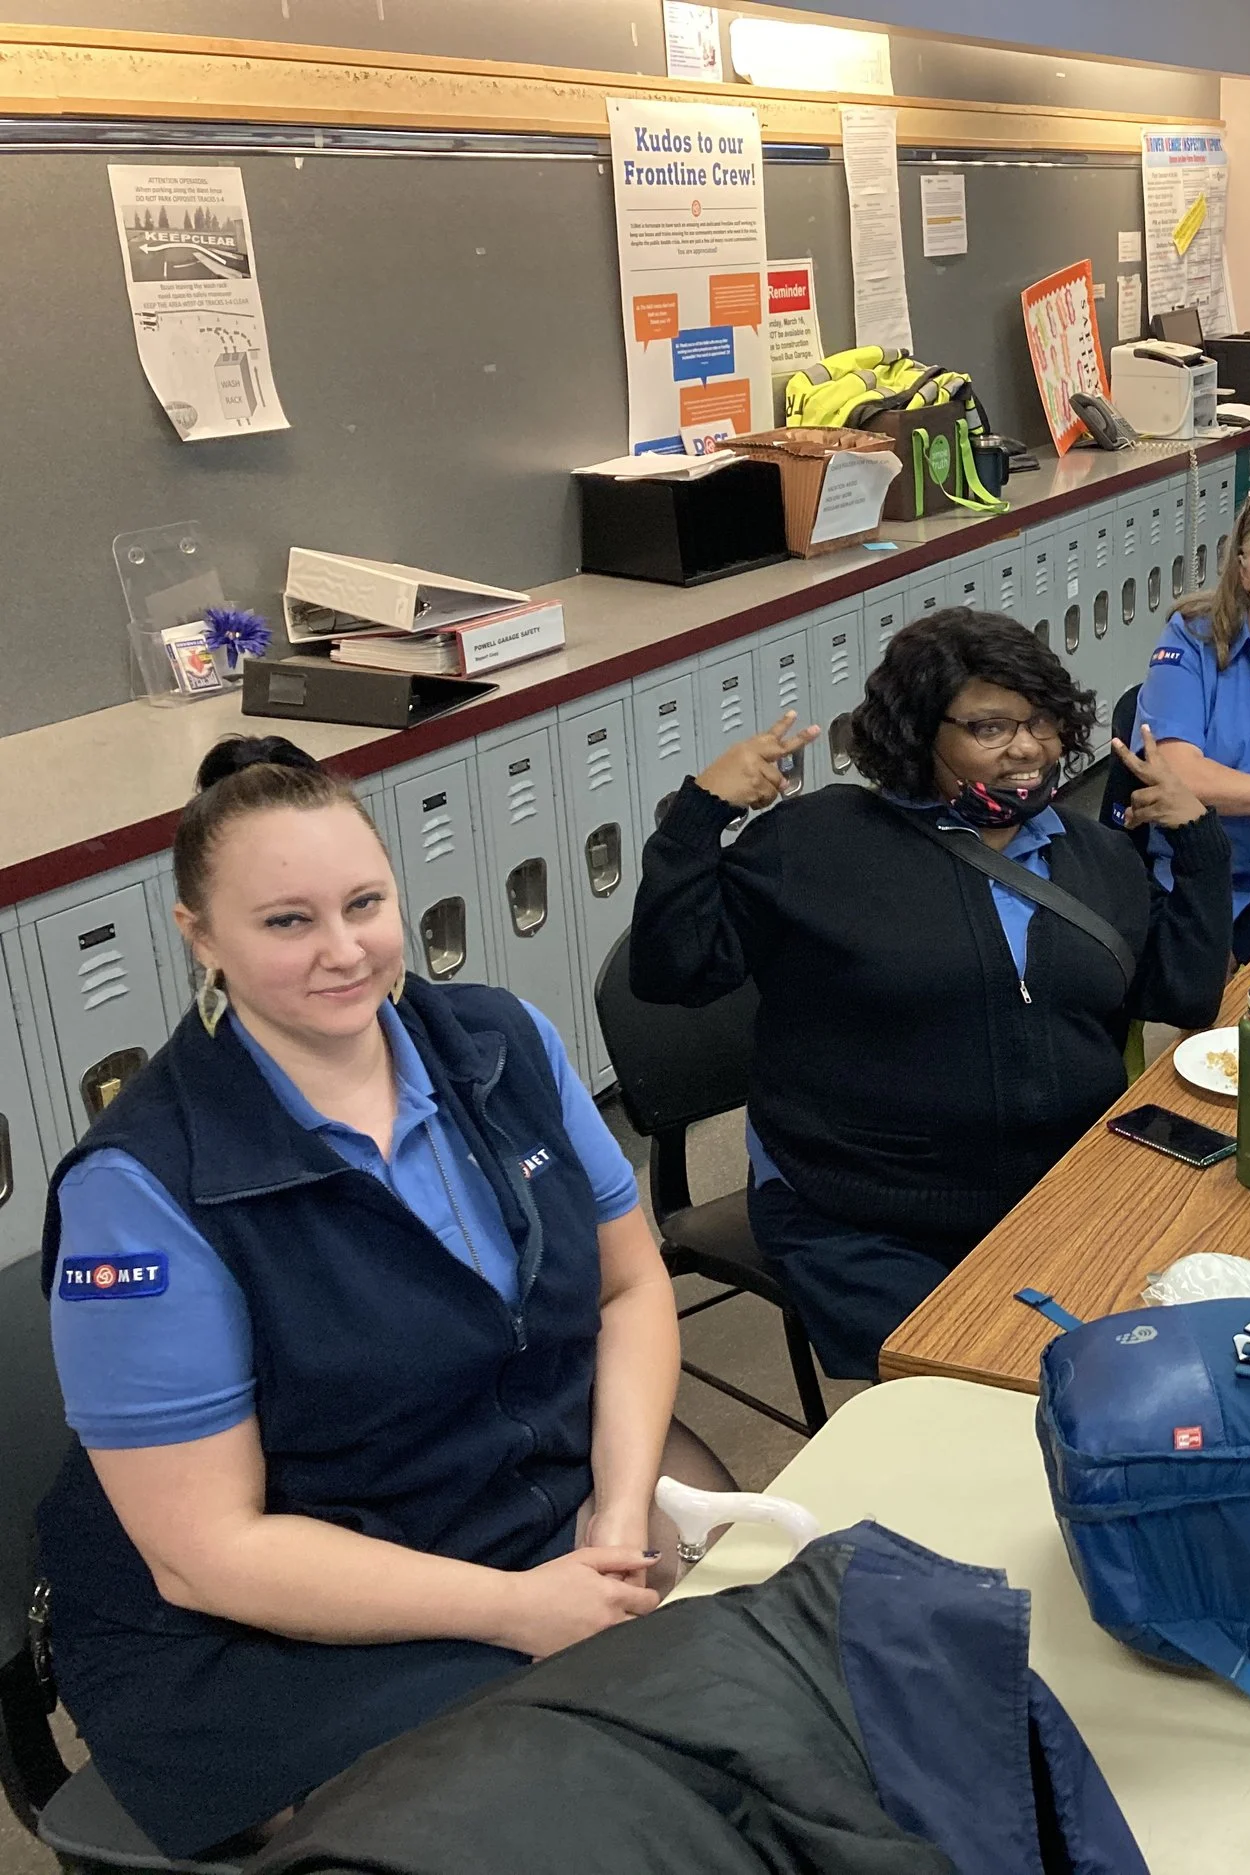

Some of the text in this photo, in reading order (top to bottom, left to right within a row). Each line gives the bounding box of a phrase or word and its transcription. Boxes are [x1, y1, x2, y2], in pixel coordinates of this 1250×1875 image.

[634, 126, 744, 154] Kudos to our
[624, 160, 756, 186] Frontline Crew!
[144, 232, 235, 246] KEEP CLEAR
[768, 283, 806, 299] Reminder
[784, 317, 797, 326] March
[769, 331, 777, 339] OT
[784, 329, 804, 337] available
[781, 340, 809, 350] construction
[770, 354, 784, 362] owell
[785, 352, 793, 361] Bus
[221, 379, 240, 389] WASH
[225, 396, 243, 404] RACK
[474, 626, 540, 651] POWELL GARAGE SAFETY
[524, 1148, 550, 1172] MET
